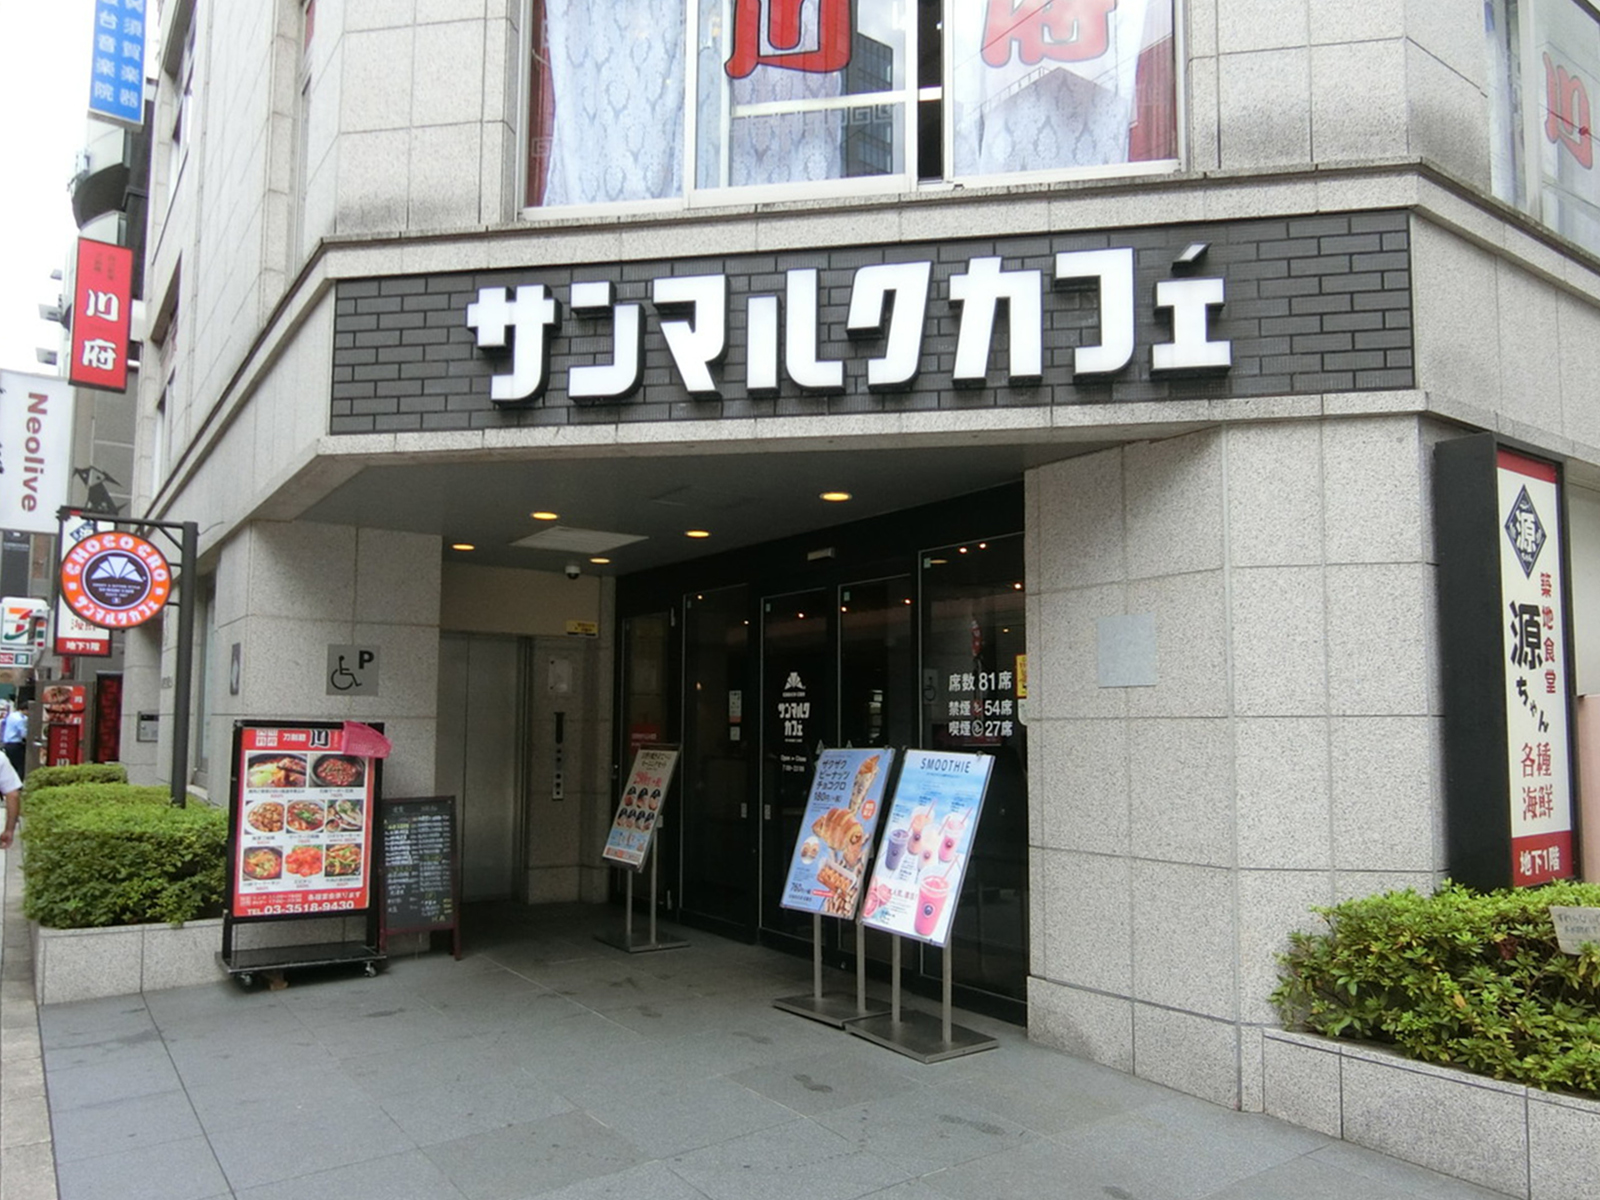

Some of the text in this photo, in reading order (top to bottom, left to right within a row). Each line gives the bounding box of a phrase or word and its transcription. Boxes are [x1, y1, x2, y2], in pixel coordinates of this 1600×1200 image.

[467, 243, 1231, 401] サンマルクカフェ
[21, 392, 48, 512] Neolive
[1515, 510, 1536, 553] 源
[65, 534, 168, 583] CHOCO CRO
[73, 595, 161, 626] サンマルクカフェ
[1540, 571, 1556, 694] 築地食堂
[359, 650, 374, 669] P
[1509, 600, 1549, 733] 源ちゃん
[920, 757, 972, 774] SMOOTHIE
[1521, 742, 1552, 778] 各種
[1522, 784, 1554, 821] 海鮮
[1519, 846, 1561, 877] 地下1階
[264, 899, 355, 916] 03-3518-9430
